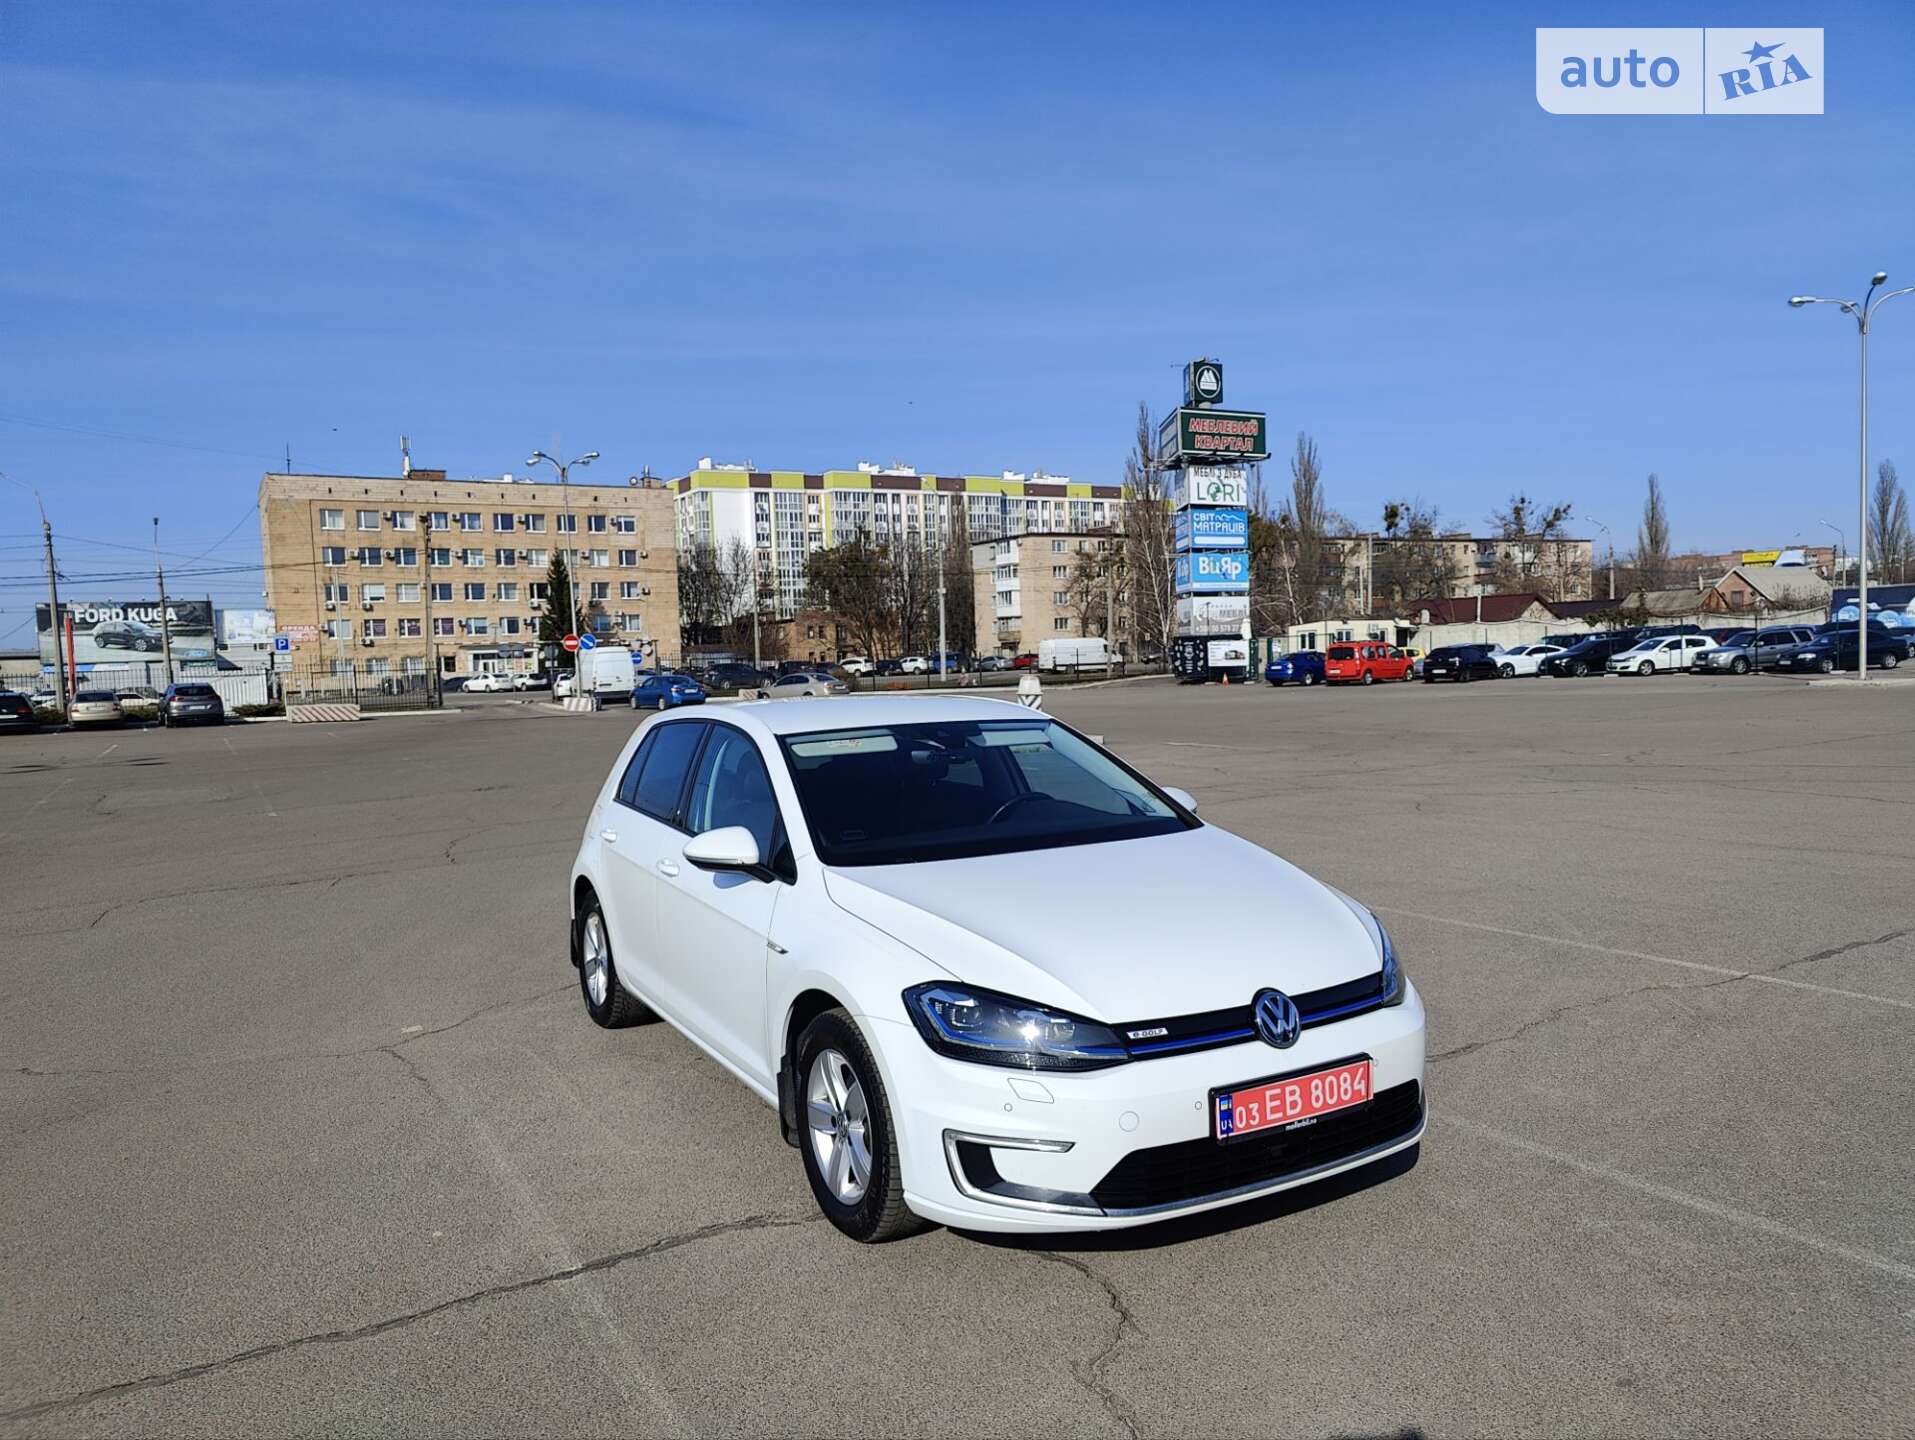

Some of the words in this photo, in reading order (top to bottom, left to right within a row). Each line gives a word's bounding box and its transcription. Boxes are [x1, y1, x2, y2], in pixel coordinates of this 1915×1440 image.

[1188, 417, 1259, 436] МЕБЛЕВИЙ
[1194, 435, 1254, 452] КВАРТАЛ
[74, 608, 124, 623] FORD
[127, 606, 178, 622] KUGA
[278, 639, 287, 650] P
[1235, 1102, 1260, 1129] 03
[1265, 1084, 1303, 1121] EB
[1310, 1066, 1367, 1109] 8084
